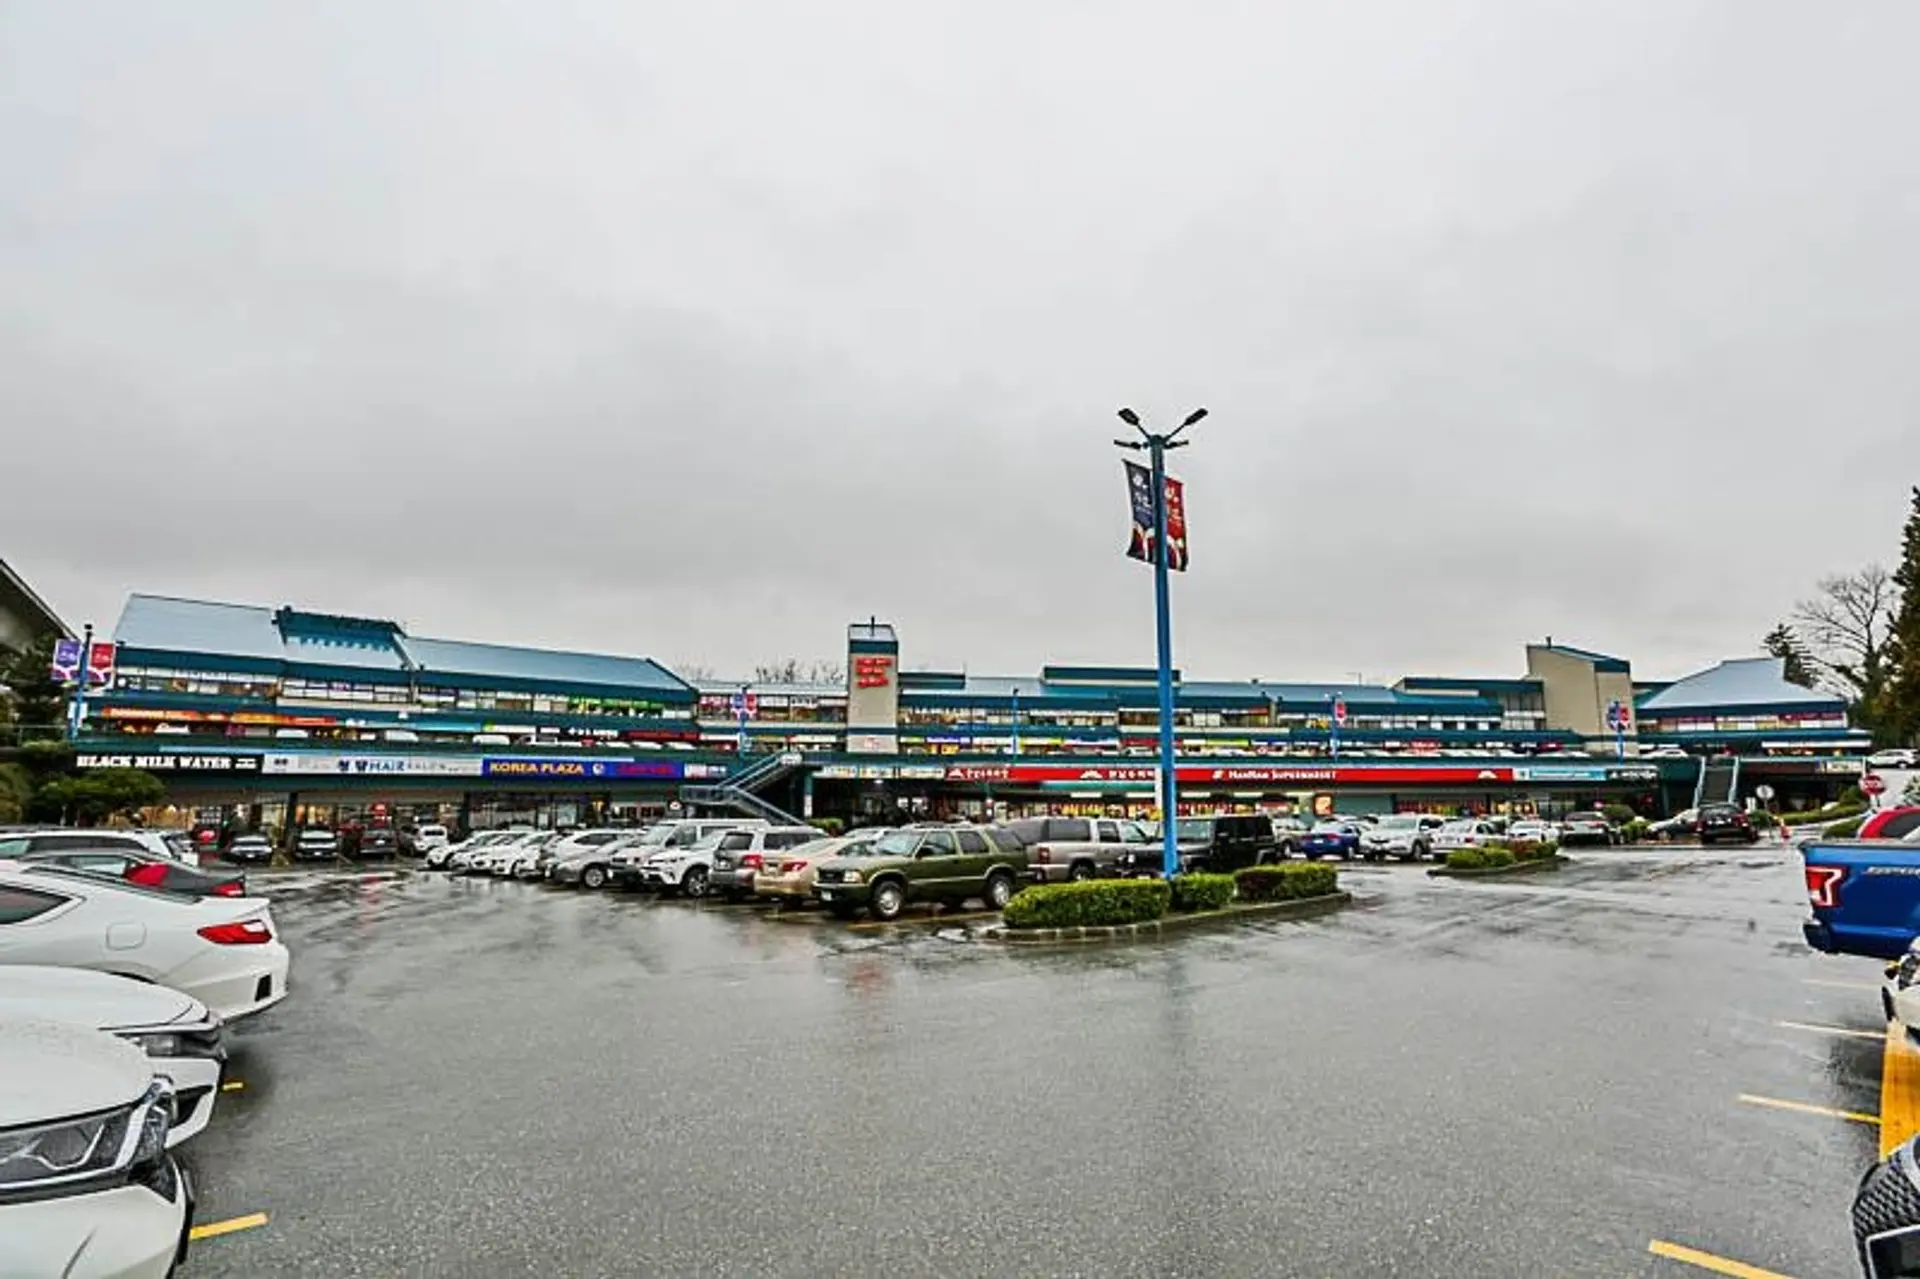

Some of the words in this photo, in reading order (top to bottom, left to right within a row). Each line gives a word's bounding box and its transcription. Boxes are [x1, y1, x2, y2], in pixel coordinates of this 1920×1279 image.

[76, 755, 132, 768] BLACK
[135, 755, 176, 769] MILK
[179, 756, 231, 770] WATER
[490, 762, 538, 774] KOREA
[541, 763, 584, 775] PLAZA
